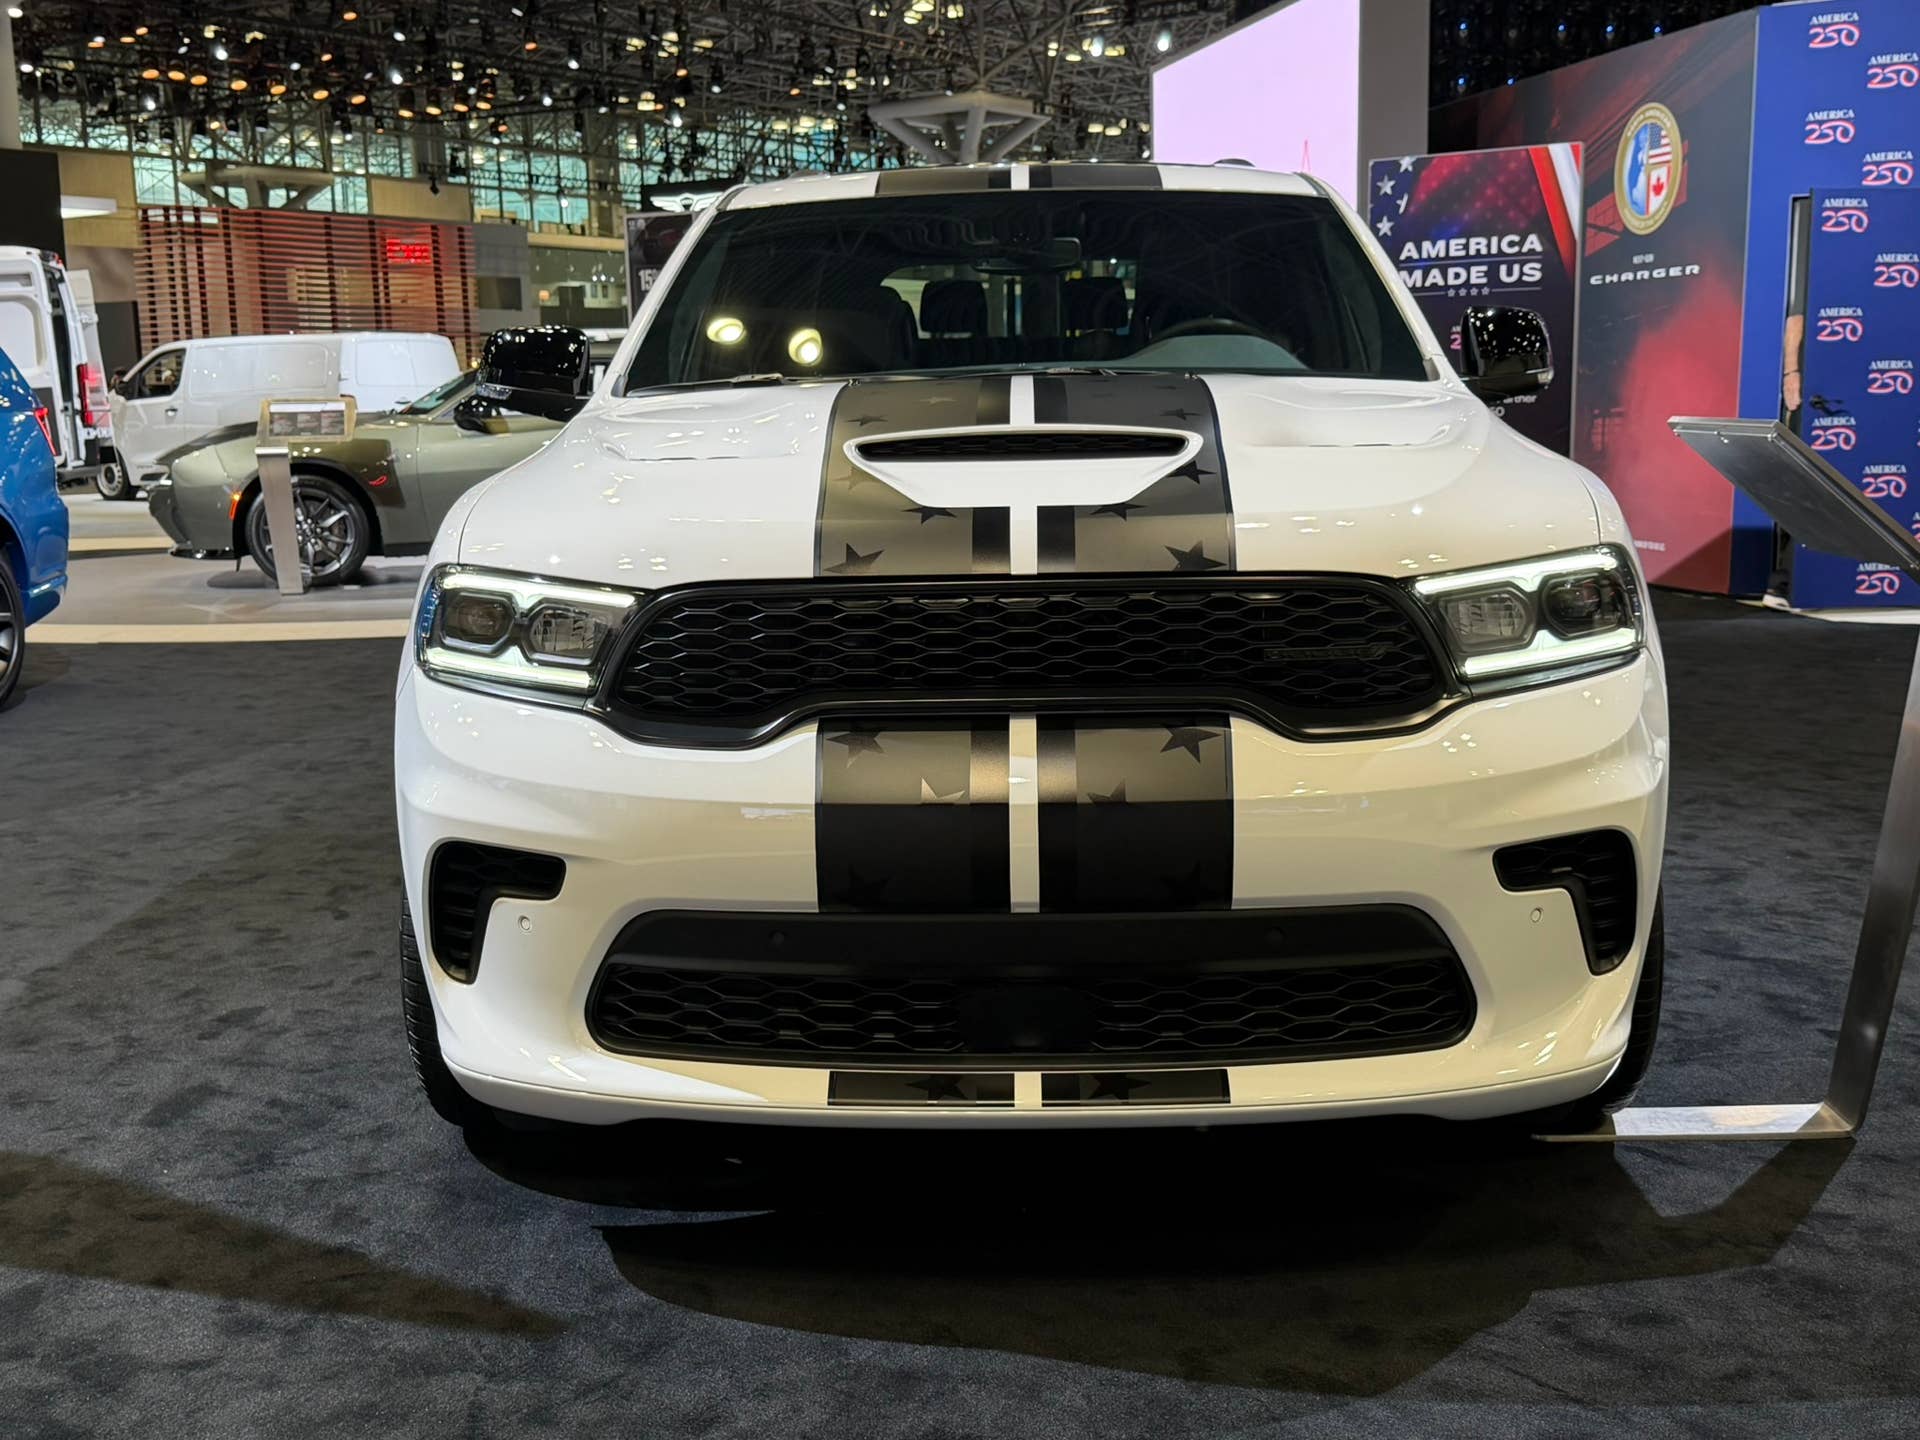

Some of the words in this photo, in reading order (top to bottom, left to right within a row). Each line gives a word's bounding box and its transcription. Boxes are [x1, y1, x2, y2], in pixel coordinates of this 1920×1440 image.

[1809, 11, 1859, 25] AMERICA
[1808, 23, 1860, 48] 250
[1868, 52, 1918, 65] AMERICA
[1867, 63, 1919, 88] 250
[1805, 109, 1855, 121] AMERICA
[1804, 119, 1855, 144] 250
[1863, 150, 1913, 162] AMERICA
[1861, 160, 1914, 185] 250
[1822, 198, 1868, 207] AMERICA
[1821, 208, 1869, 233] 250
[1400, 233, 1543, 260] AMERICA
[1875, 253, 1919, 263] AMERICA
[1399, 265, 1488, 288] MADE
[1499, 262, 1542, 284] US
[1588, 263, 1701, 286] CHARGER
[1873, 263, 1920, 287] 250
[1818, 306, 1863, 317] AMERICA
[1816, 317, 1863, 342] 250
[1868, 360, 1913, 370] AMERICA
[1867, 370, 1914, 395] 250
[1812, 416, 1856, 426] AMERICA
[1810, 426, 1856, 451] 250
[1862, 464, 1907, 474] AMERICA
[1862, 474, 1908, 498] 250
[1855, 571, 1900, 595] 250
